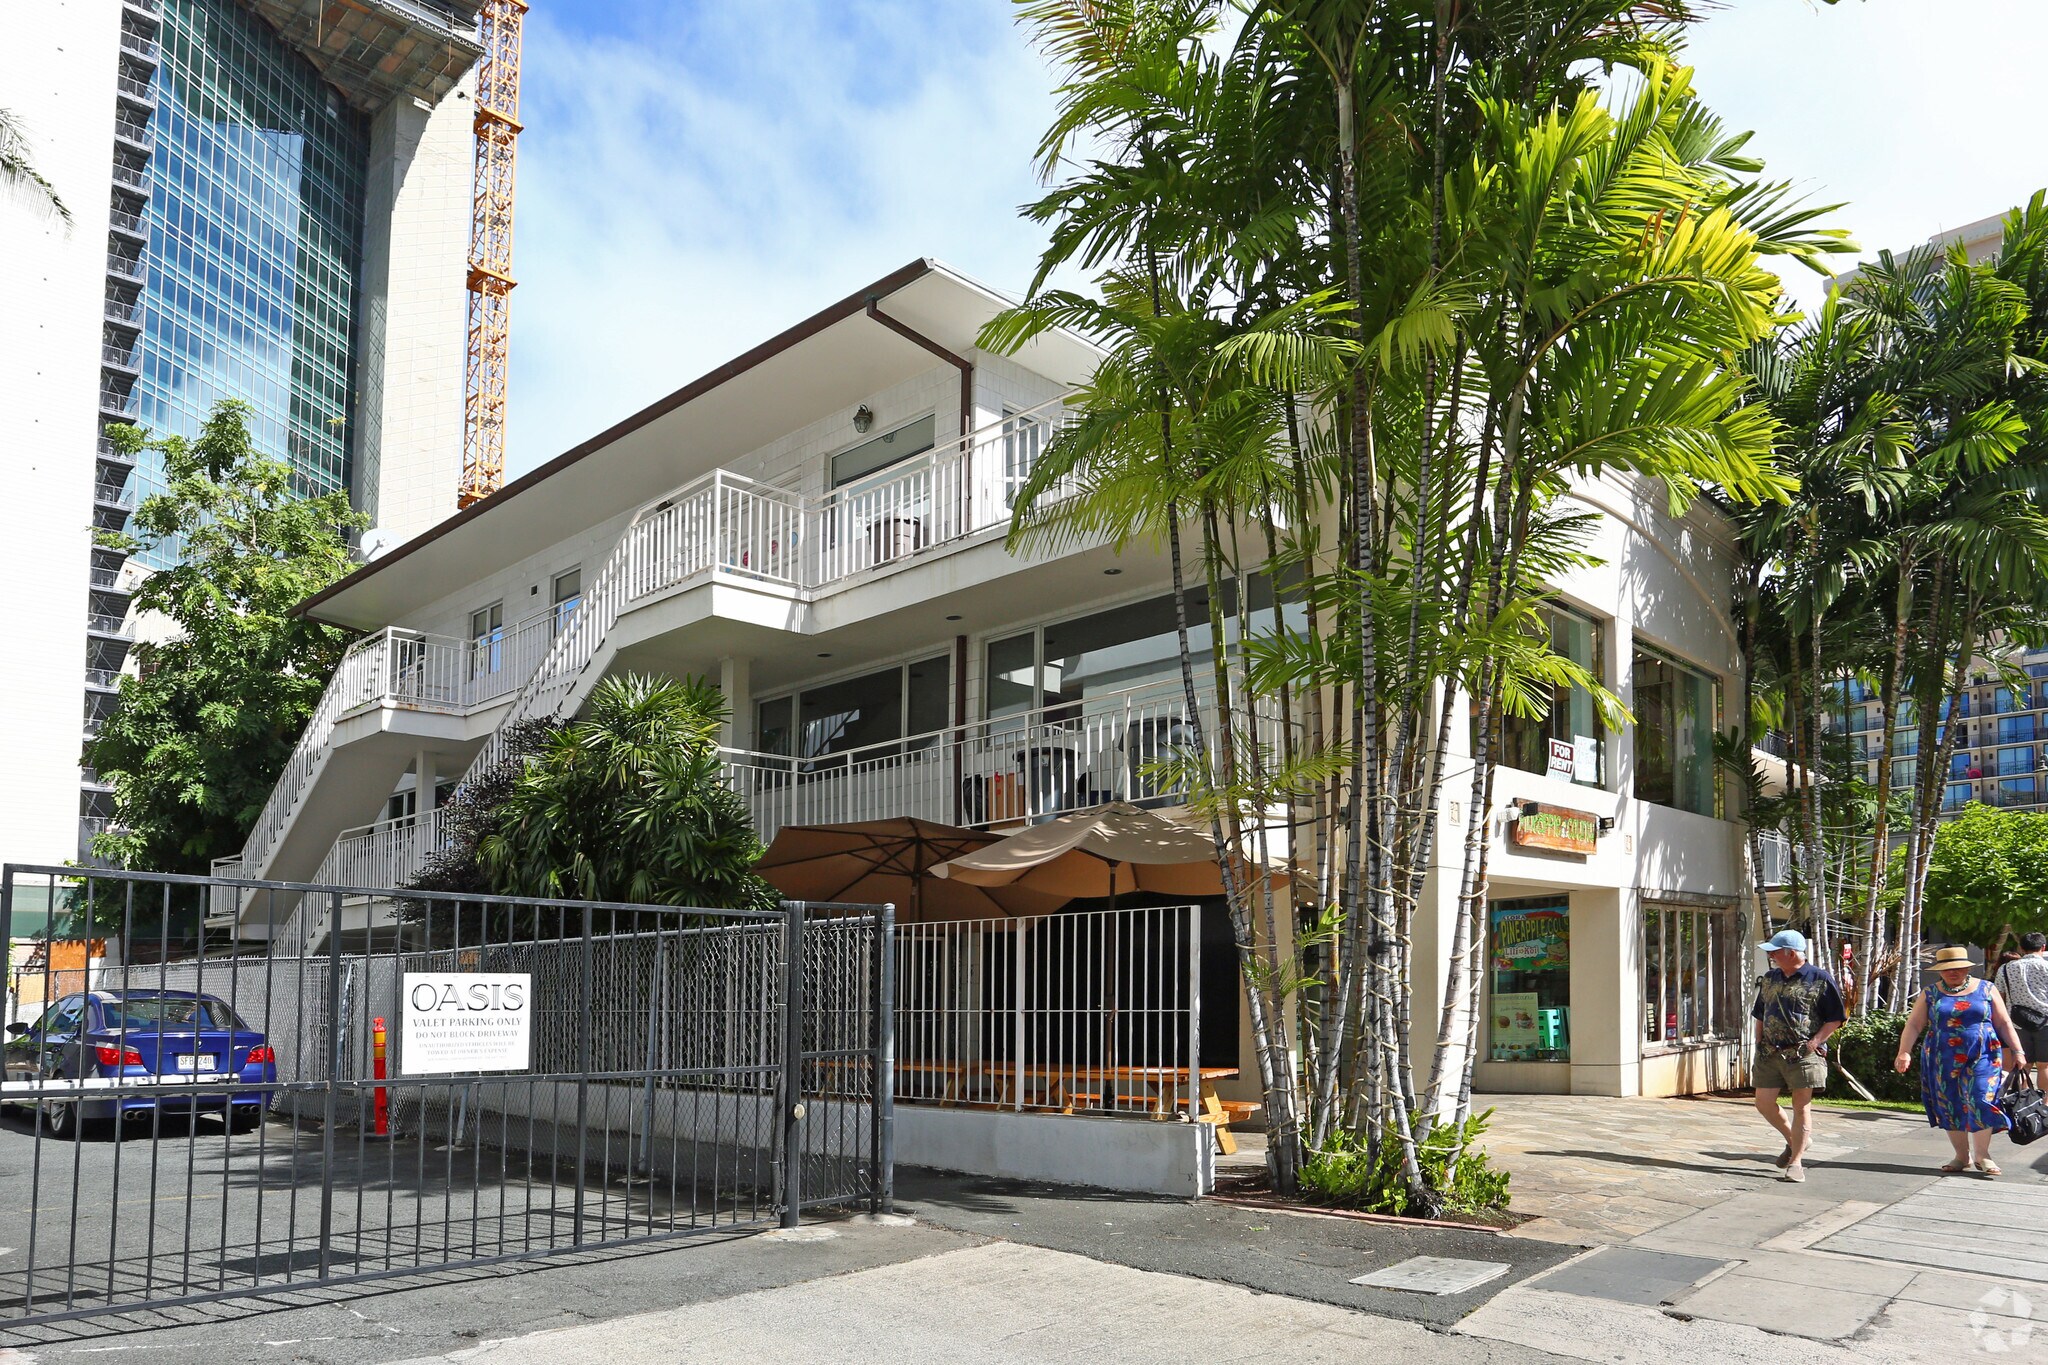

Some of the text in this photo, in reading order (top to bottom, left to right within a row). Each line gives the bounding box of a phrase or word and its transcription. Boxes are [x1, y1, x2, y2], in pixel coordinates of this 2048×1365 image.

[1553, 744, 1571, 759] FOR
[1550, 757, 1573, 773] RENT
[1500, 918, 1547, 947] PINEAPPLE
[411, 983, 524, 1012] OASIS
[413, 1017, 522, 1027] VALET PARKING ONLY
[415, 1031, 429, 1039] DO
[431, 1031, 447, 1039] NOT
